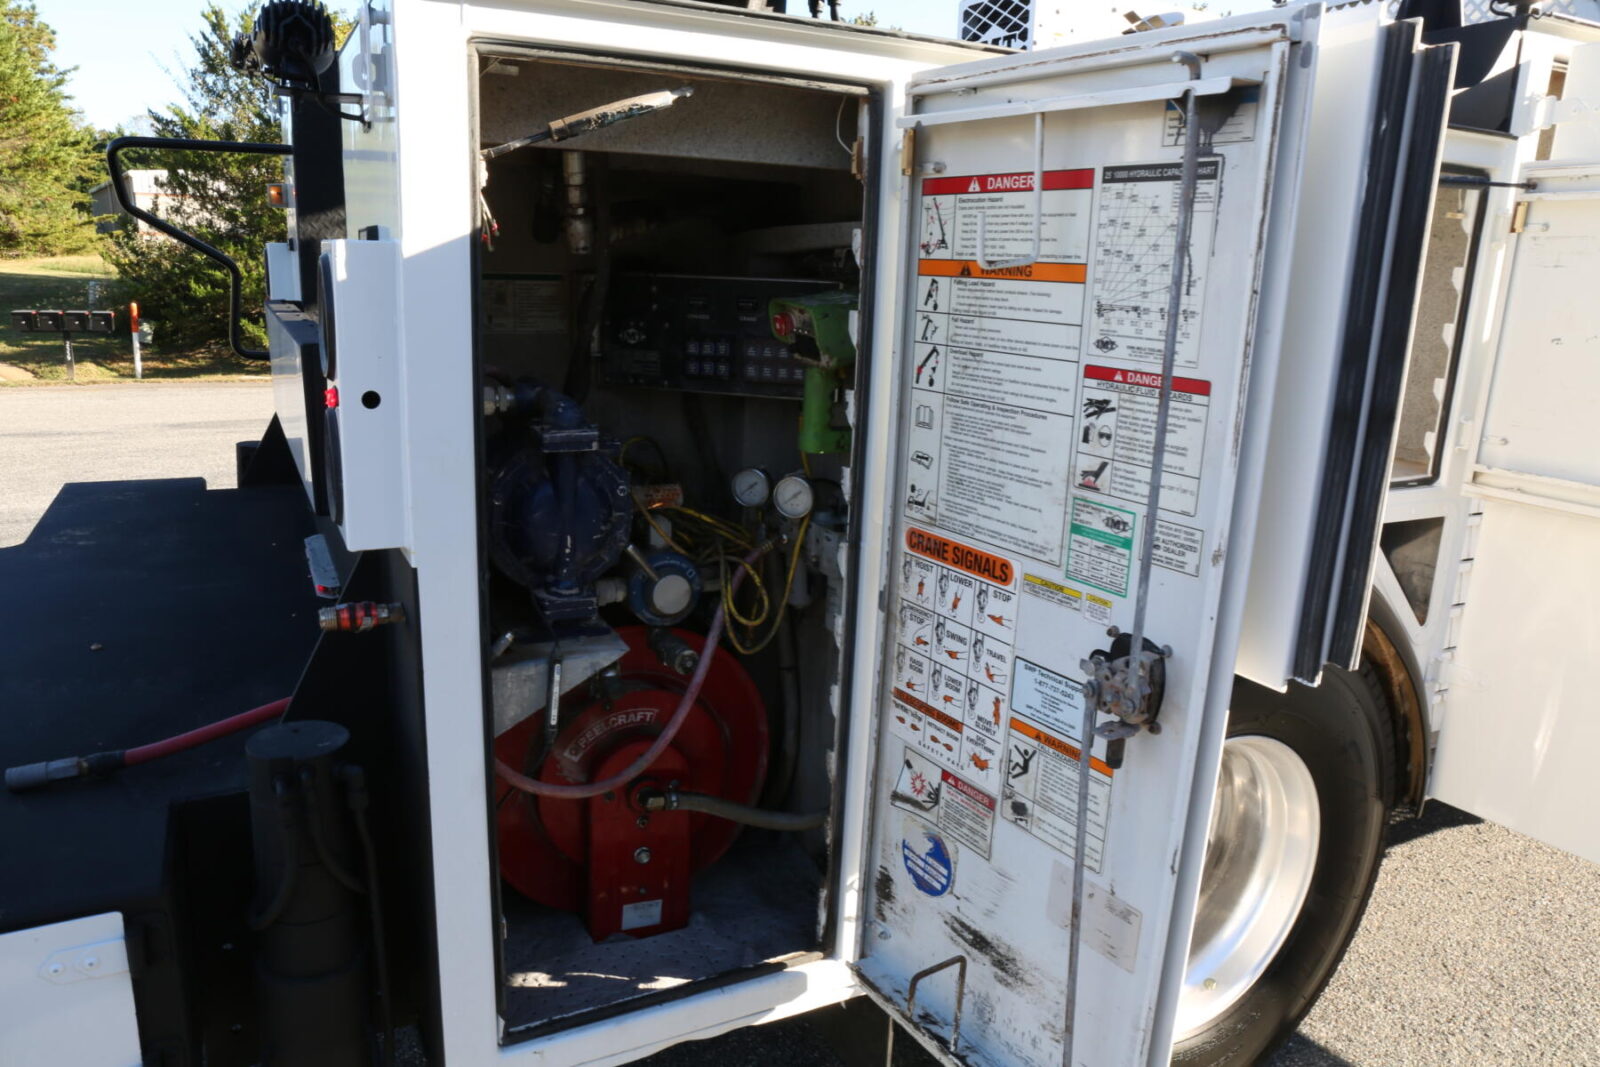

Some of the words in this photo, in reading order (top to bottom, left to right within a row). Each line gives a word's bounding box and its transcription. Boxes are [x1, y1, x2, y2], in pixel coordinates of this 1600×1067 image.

[1129, 168, 1163, 178] HYDRAULIC
[1197, 166, 1216, 175] HART
[987, 175, 1035, 190] DANGER
[1127, 372, 1164, 387] DANGE
[1097, 381, 1136, 394] HYDRAULIC
[1136, 386, 1156, 397] FLUID
[1021, 409, 1048, 420] Procedures
[1103, 516, 1130, 533] IMT
[1161, 538, 1198, 553] AUTHORIZED
[1162, 545, 1186, 557] DEALER
[909, 530, 950, 561] CRANE
[952, 545, 1009, 583] SIGNALS
[914, 558, 934, 573] HOIST
[950, 573, 973, 589] LOWER
[992, 589, 1012, 603] STOP
[909, 613, 925, 624] STOP
[946, 629, 968, 646] SWING
[986, 648, 1007, 664] TRAVEL
[909, 663, 924, 675] BOOM
[944, 674, 962, 687] LOWER
[945, 681, 961, 694] BOOM
[977, 714, 993, 727] MOVE
[975, 720, 997, 737] SLOWLY
[965, 735, 995, 756] EVERYTHING
[918, 740, 944, 757] SAFETY
[946, 756, 965, 771] PAYS
